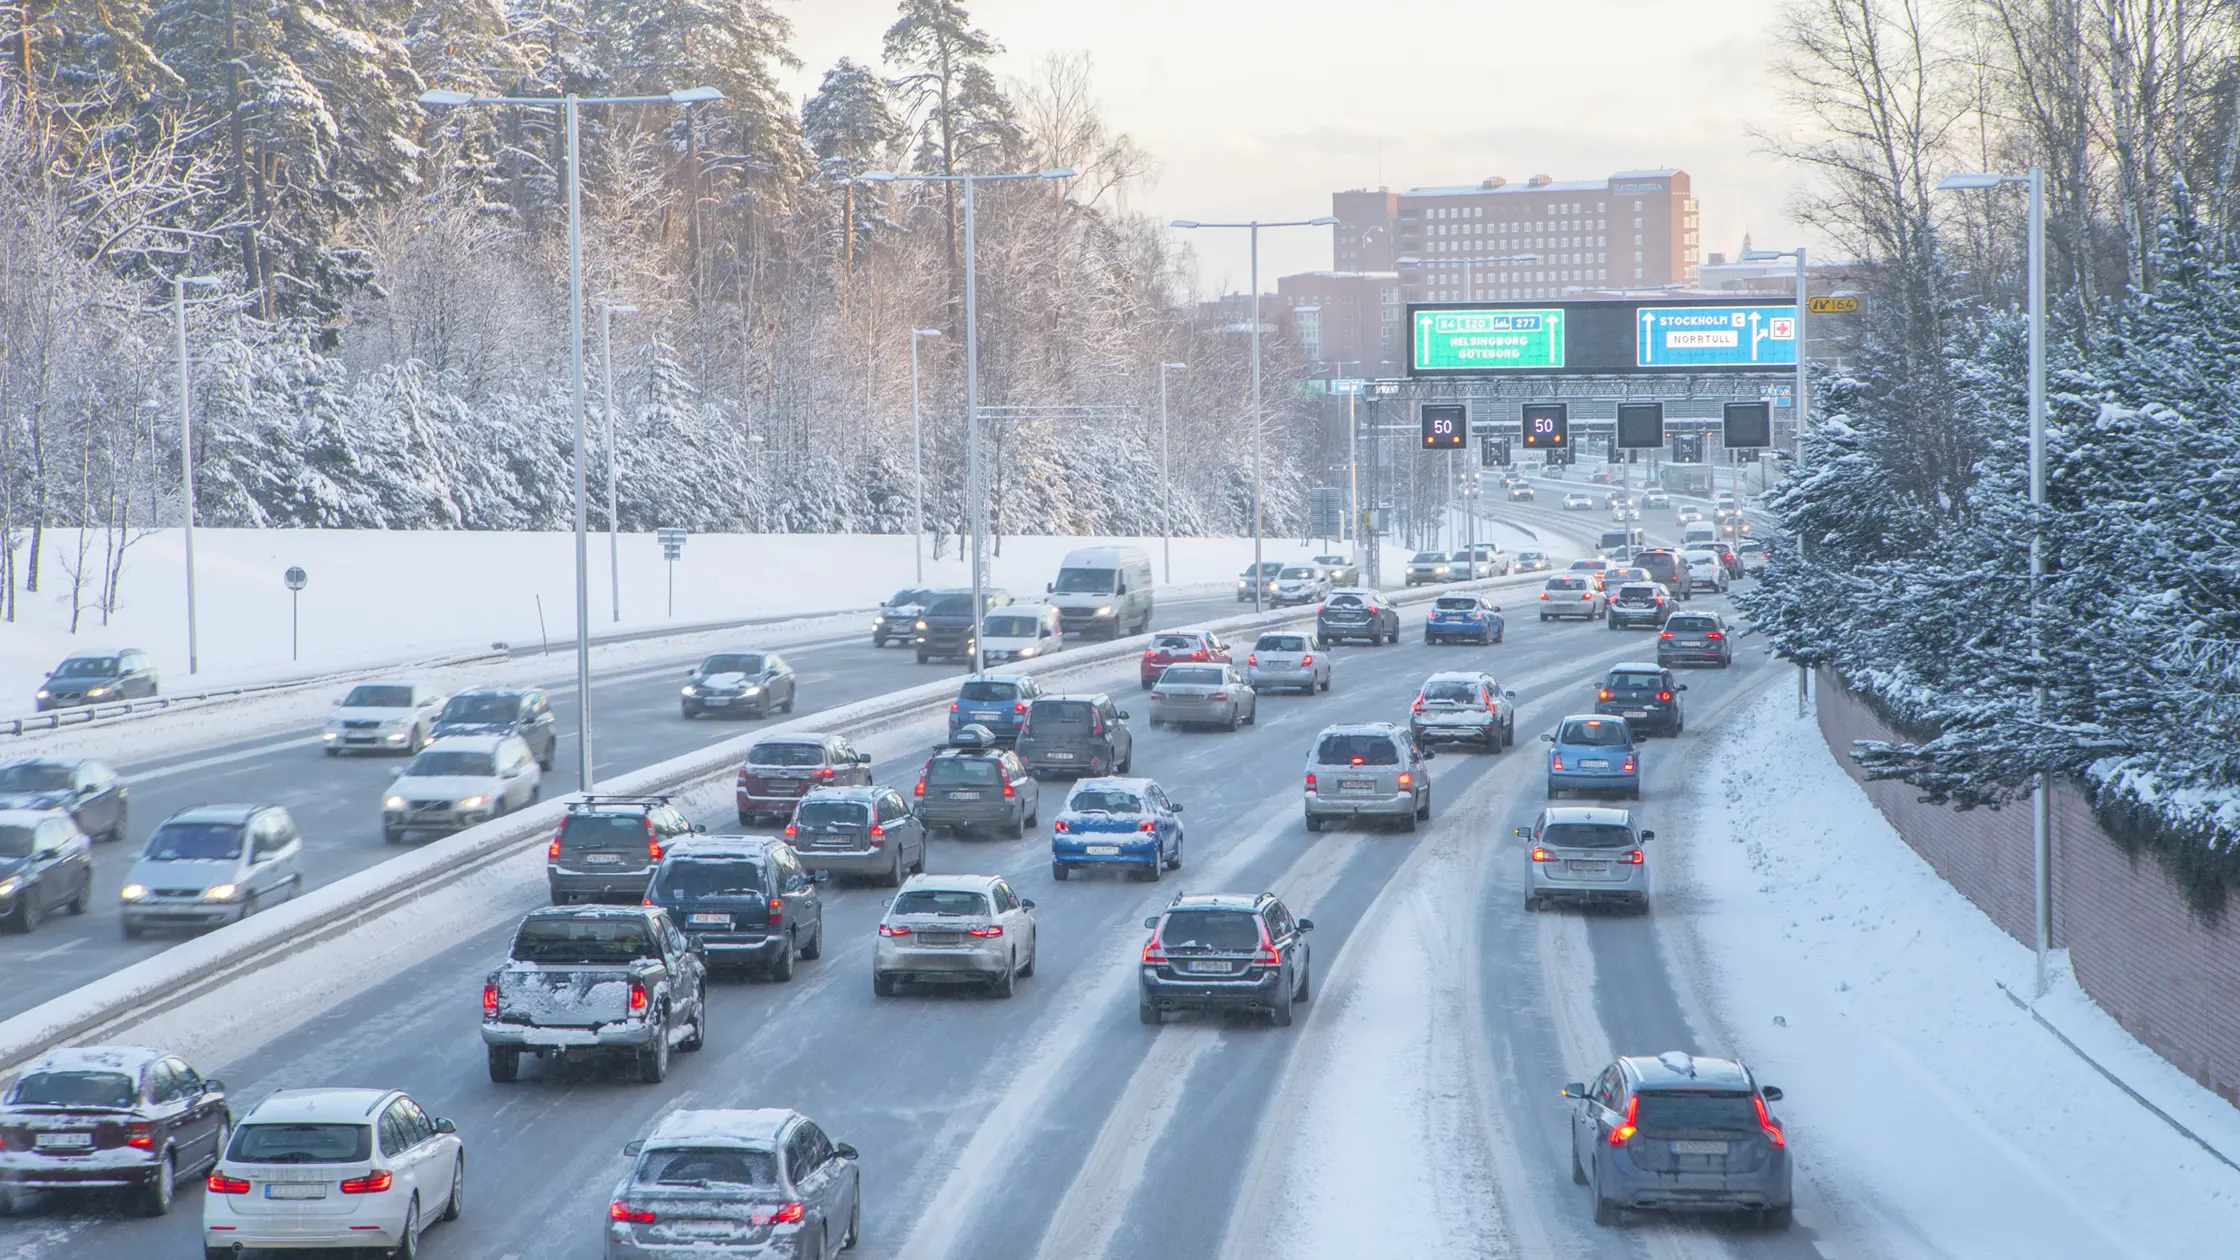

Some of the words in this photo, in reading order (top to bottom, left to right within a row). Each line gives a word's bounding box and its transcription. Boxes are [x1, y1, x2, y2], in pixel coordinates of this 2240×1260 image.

[1832, 300, 1853, 310] 164
[1440, 319, 1455, 329] E4
[1465, 319, 1486, 328] E20
[1516, 318, 1535, 328] 277
[1660, 316, 1728, 326] STOCKHOLM
[1450, 336, 1528, 347] HELSINGBORG
[1674, 335, 1731, 344] NORRTULL
[1458, 348, 1520, 359] GÖTEBORG
[1434, 419, 1452, 434] 50
[1534, 418, 1553, 433] 50
